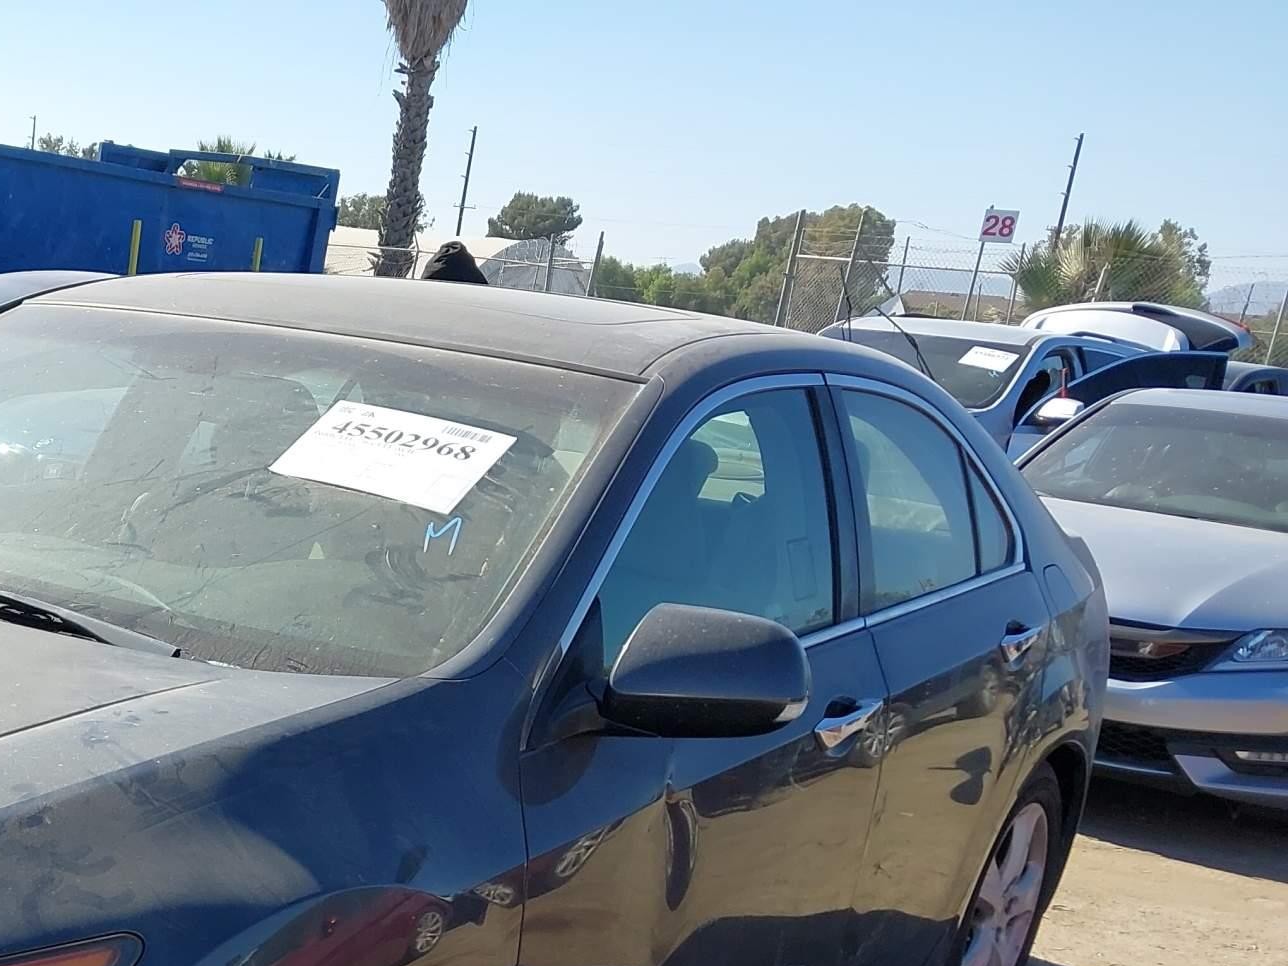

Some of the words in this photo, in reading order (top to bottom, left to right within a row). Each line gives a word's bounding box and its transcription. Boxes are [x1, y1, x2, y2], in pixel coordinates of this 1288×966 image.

[982, 215, 1016, 237] 28
[332, 420, 478, 461] 45502968
[423, 515, 463, 556] M
